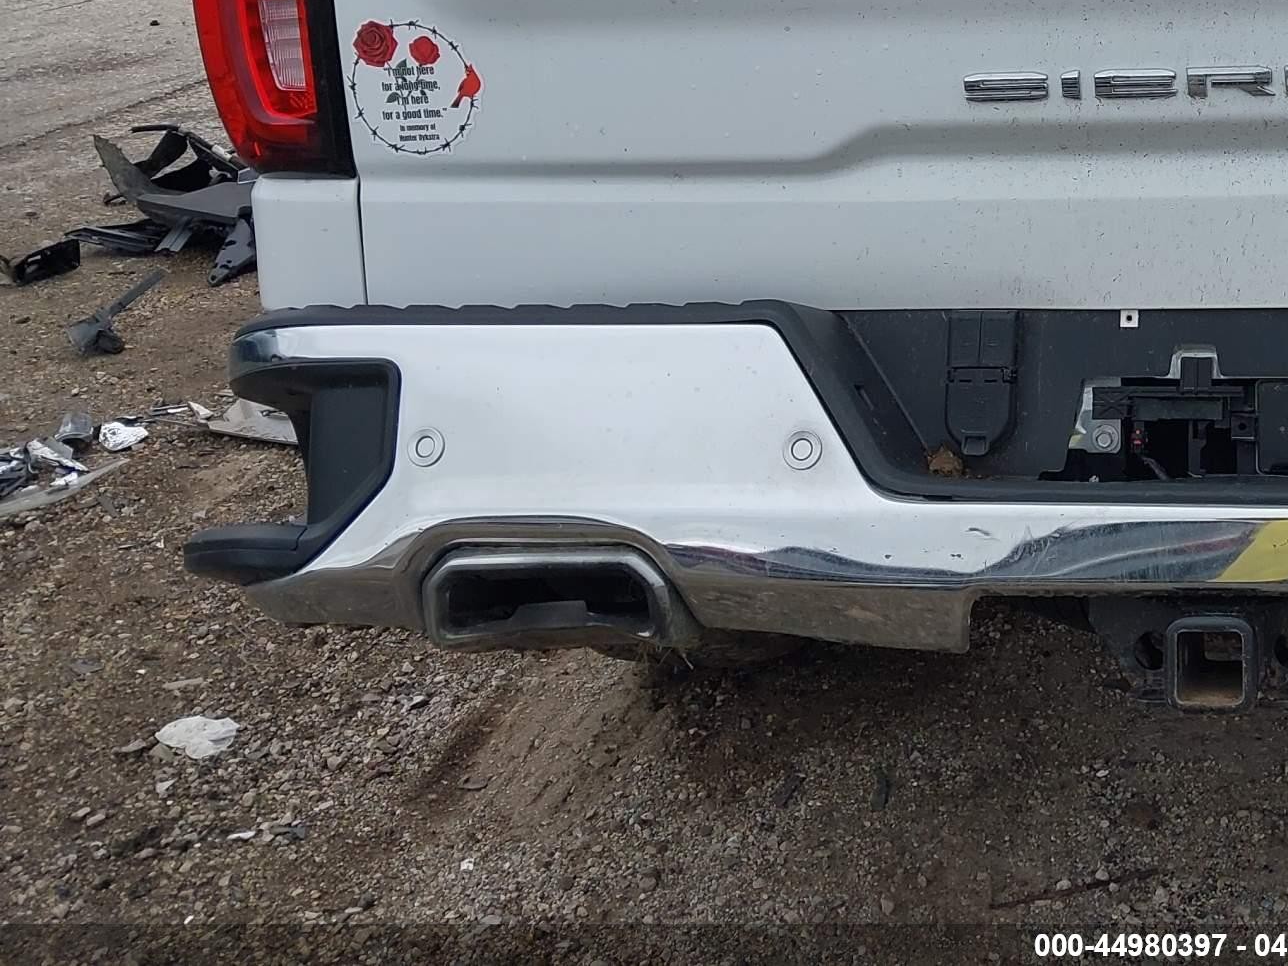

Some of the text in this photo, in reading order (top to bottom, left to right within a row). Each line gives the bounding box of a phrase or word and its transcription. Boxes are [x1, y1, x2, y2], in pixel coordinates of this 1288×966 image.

[400, 66, 415, 76] not
[416, 66, 434, 76] here
[382, 82, 393, 91] for
[401, 81, 419, 92] long
[411, 95, 429, 105] here
[382, 111, 393, 120] for
[395, 111, 401, 120] a
[402, 109, 422, 120] good
